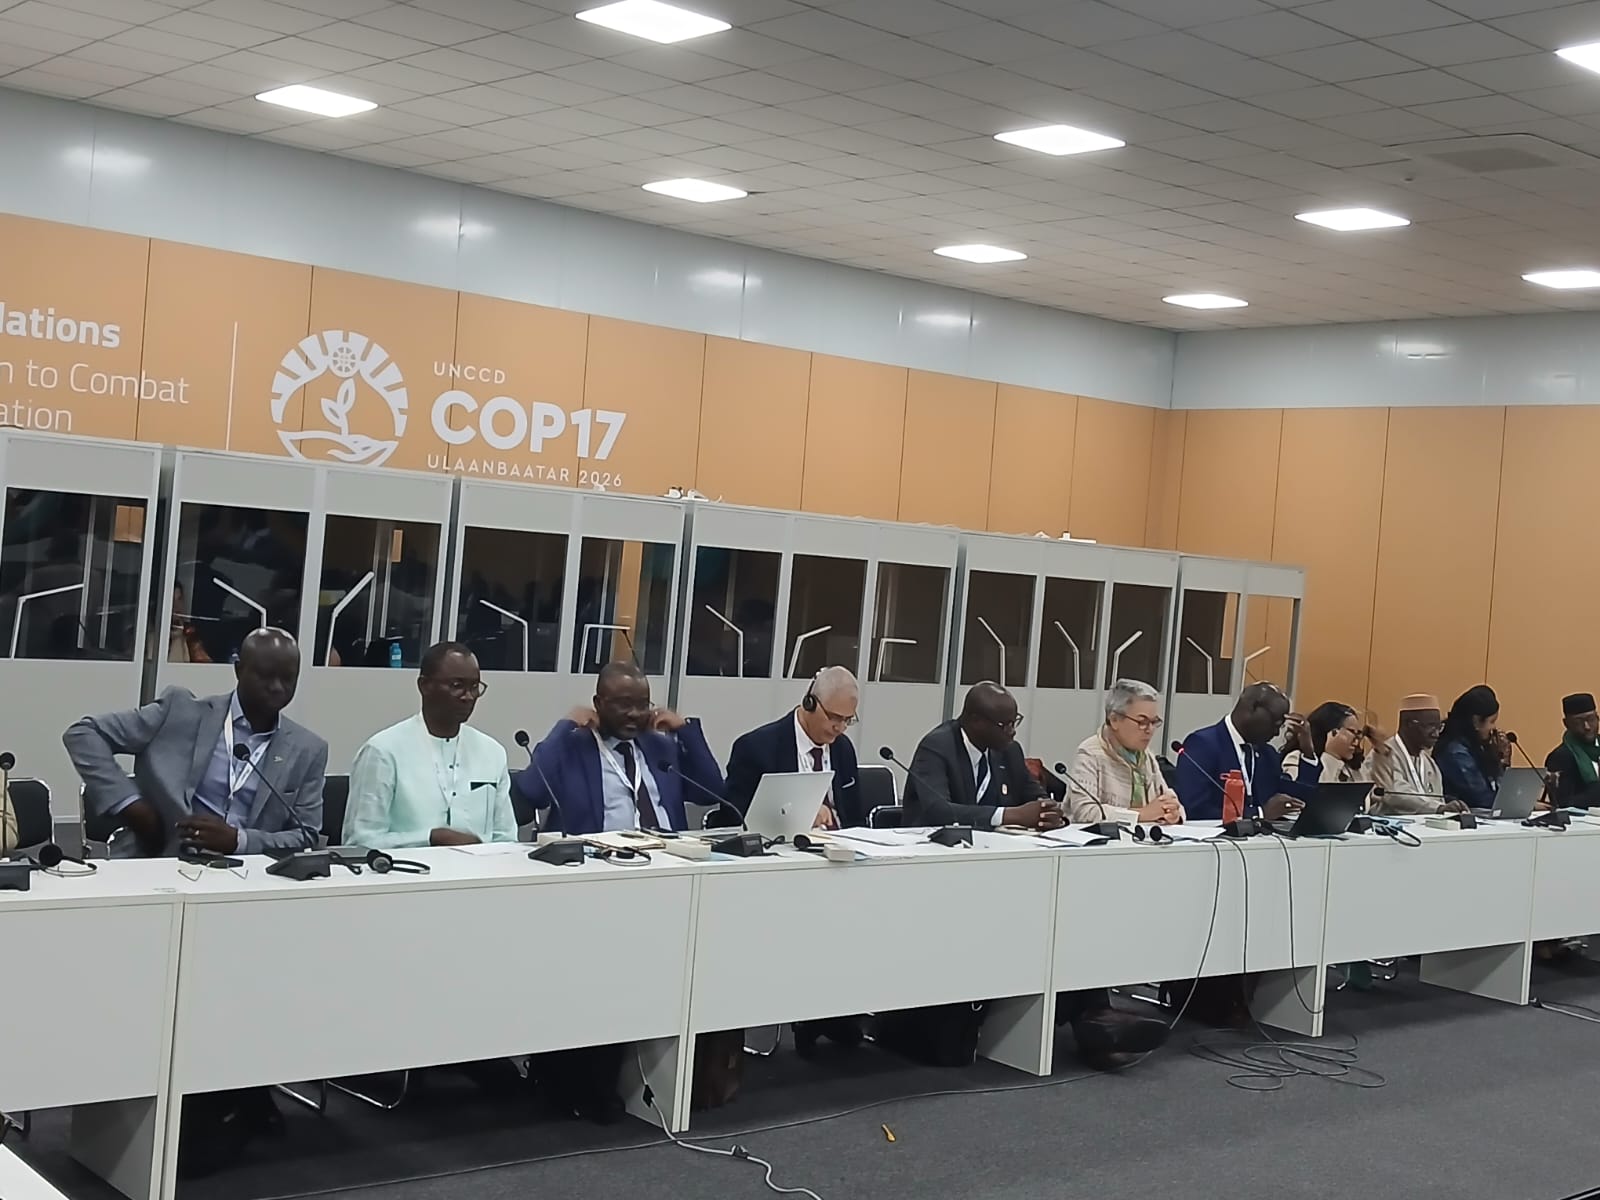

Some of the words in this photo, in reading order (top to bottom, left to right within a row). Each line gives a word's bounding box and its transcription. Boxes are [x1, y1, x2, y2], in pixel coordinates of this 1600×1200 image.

[0, 301, 121, 349] ations
[26, 359, 58, 389] to
[70, 362, 190, 404] Combat
[433, 361, 506, 384] UNCCD
[430, 389, 627, 460] COP17
[427, 454, 569, 482] ULAANBAATAR
[579, 470, 622, 487] 2026
